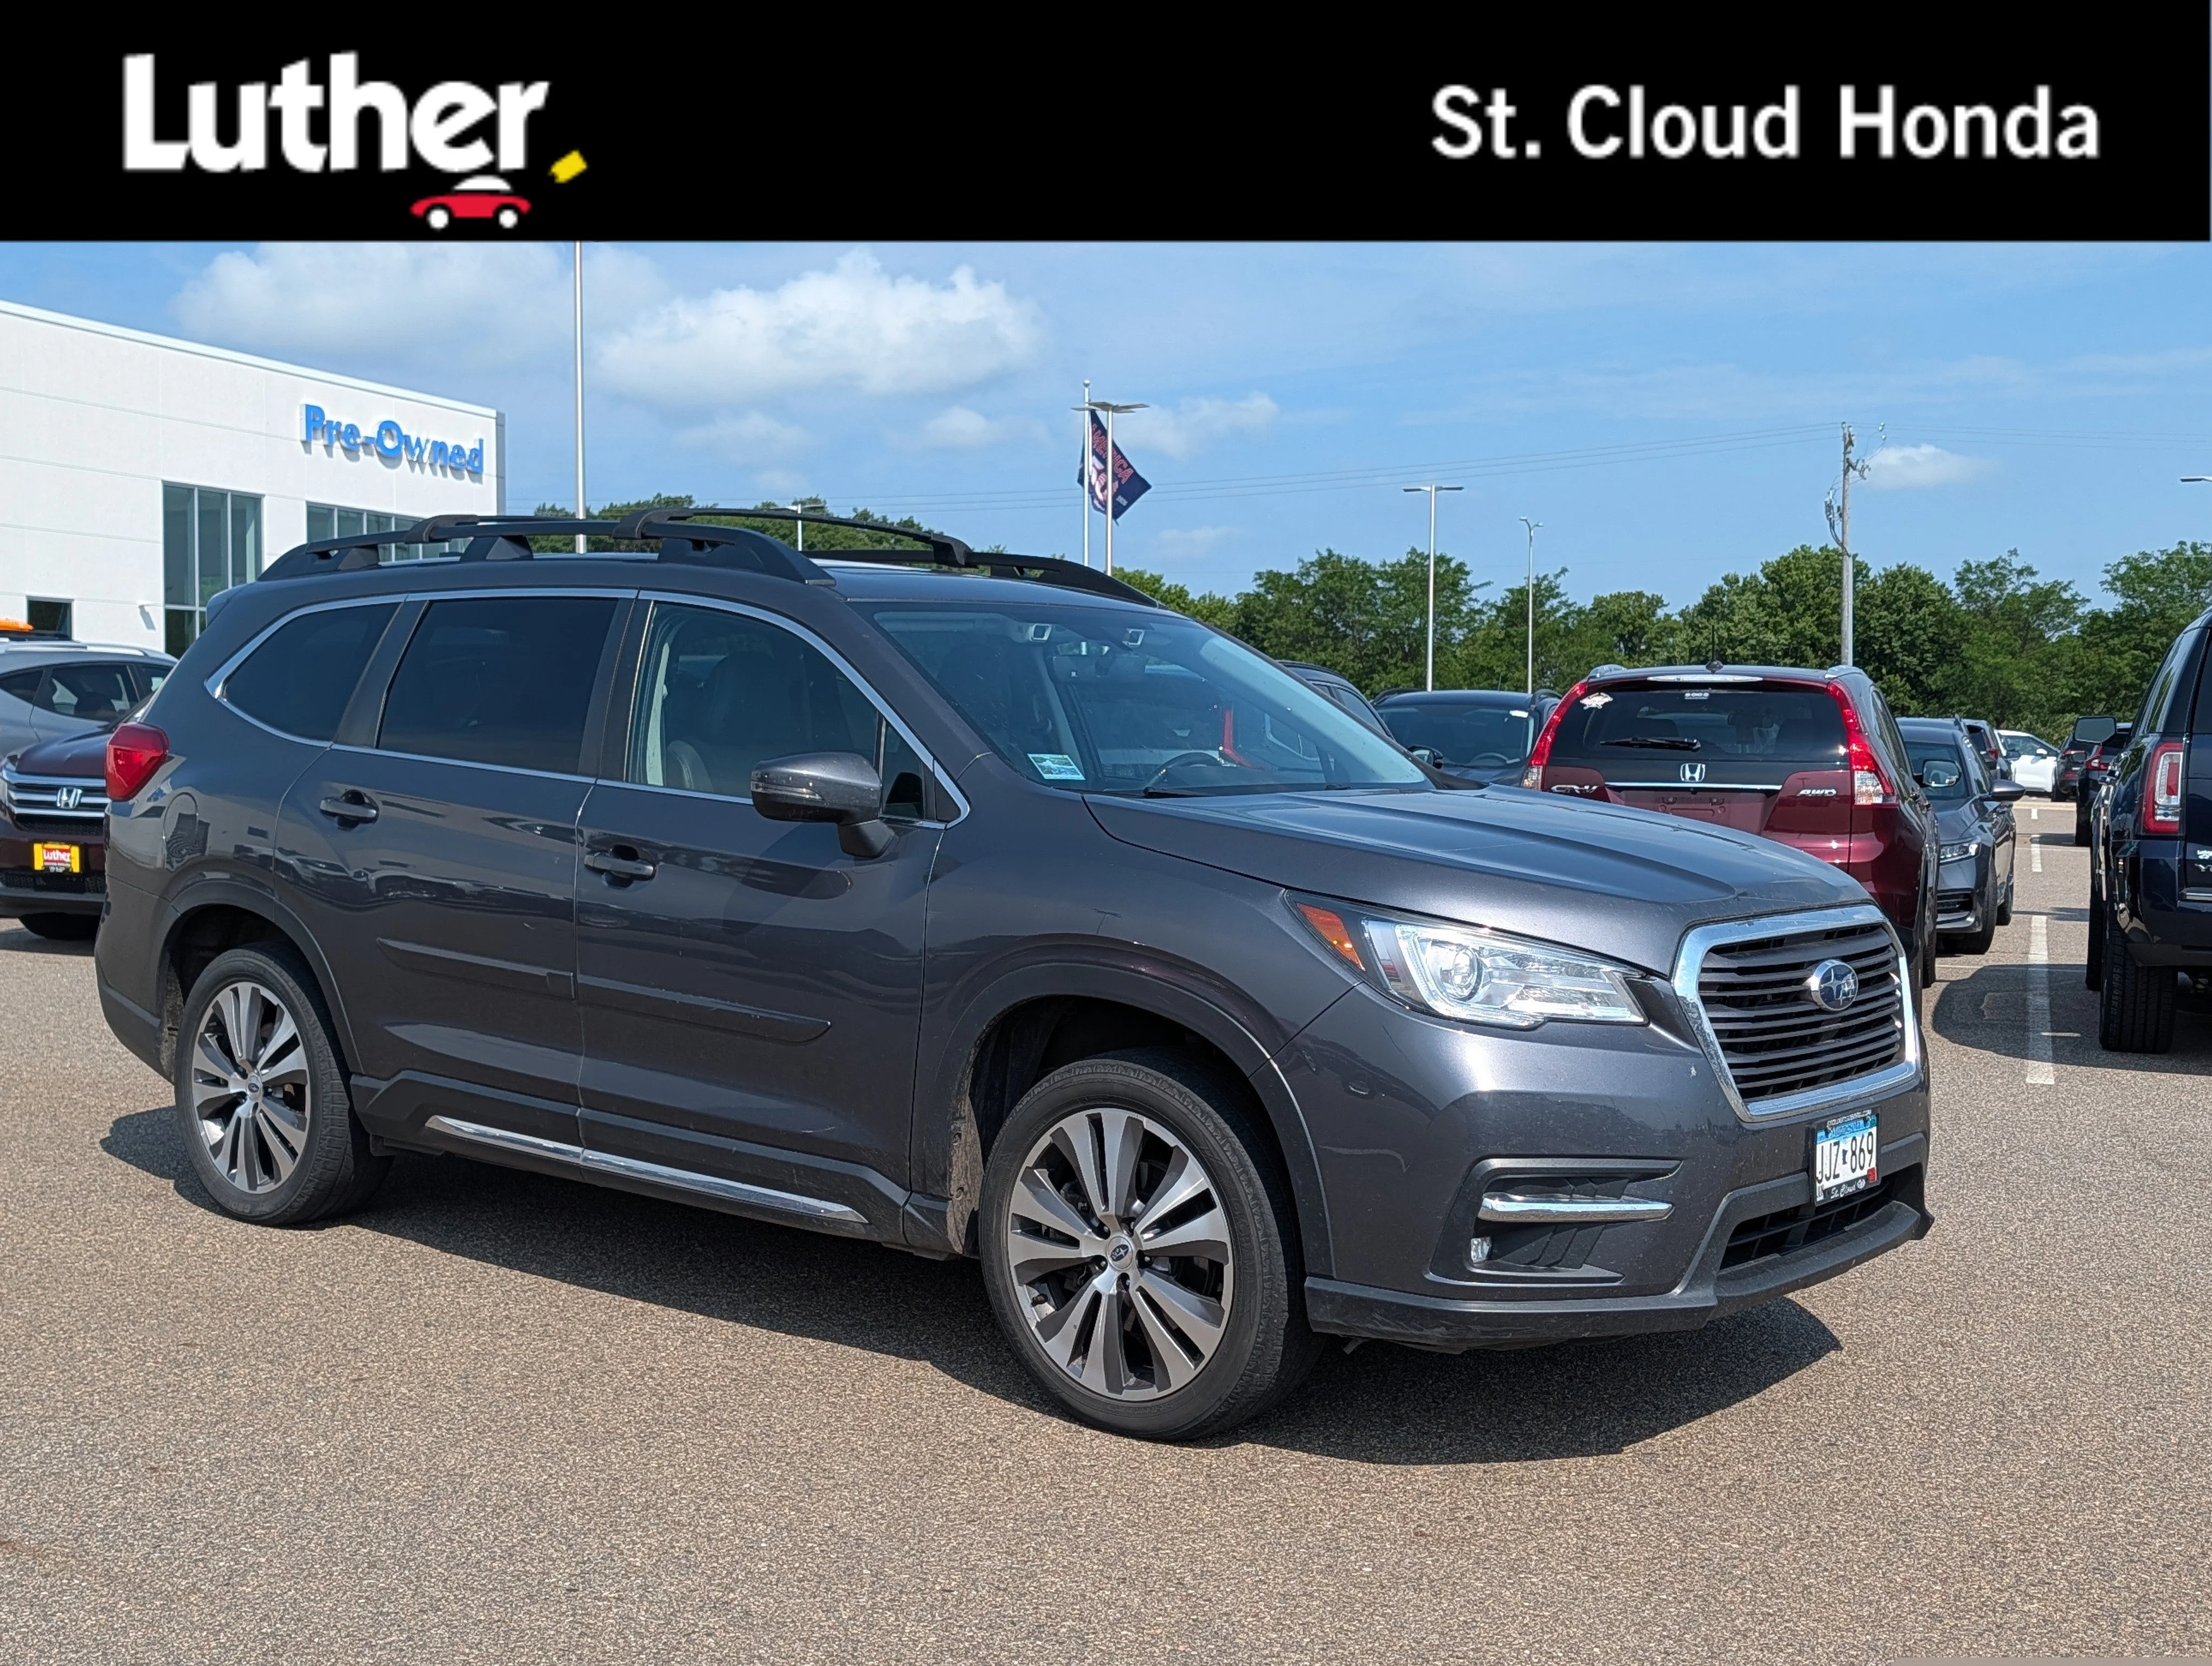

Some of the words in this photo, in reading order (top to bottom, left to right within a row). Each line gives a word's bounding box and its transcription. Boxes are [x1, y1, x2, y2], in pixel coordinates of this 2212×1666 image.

[303, 403, 484, 474] Pre-Owned
[1796, 789, 1837, 797] AWD
[1816, 1140, 1840, 1184] JJZ
[1850, 1131, 1874, 1174] 869
